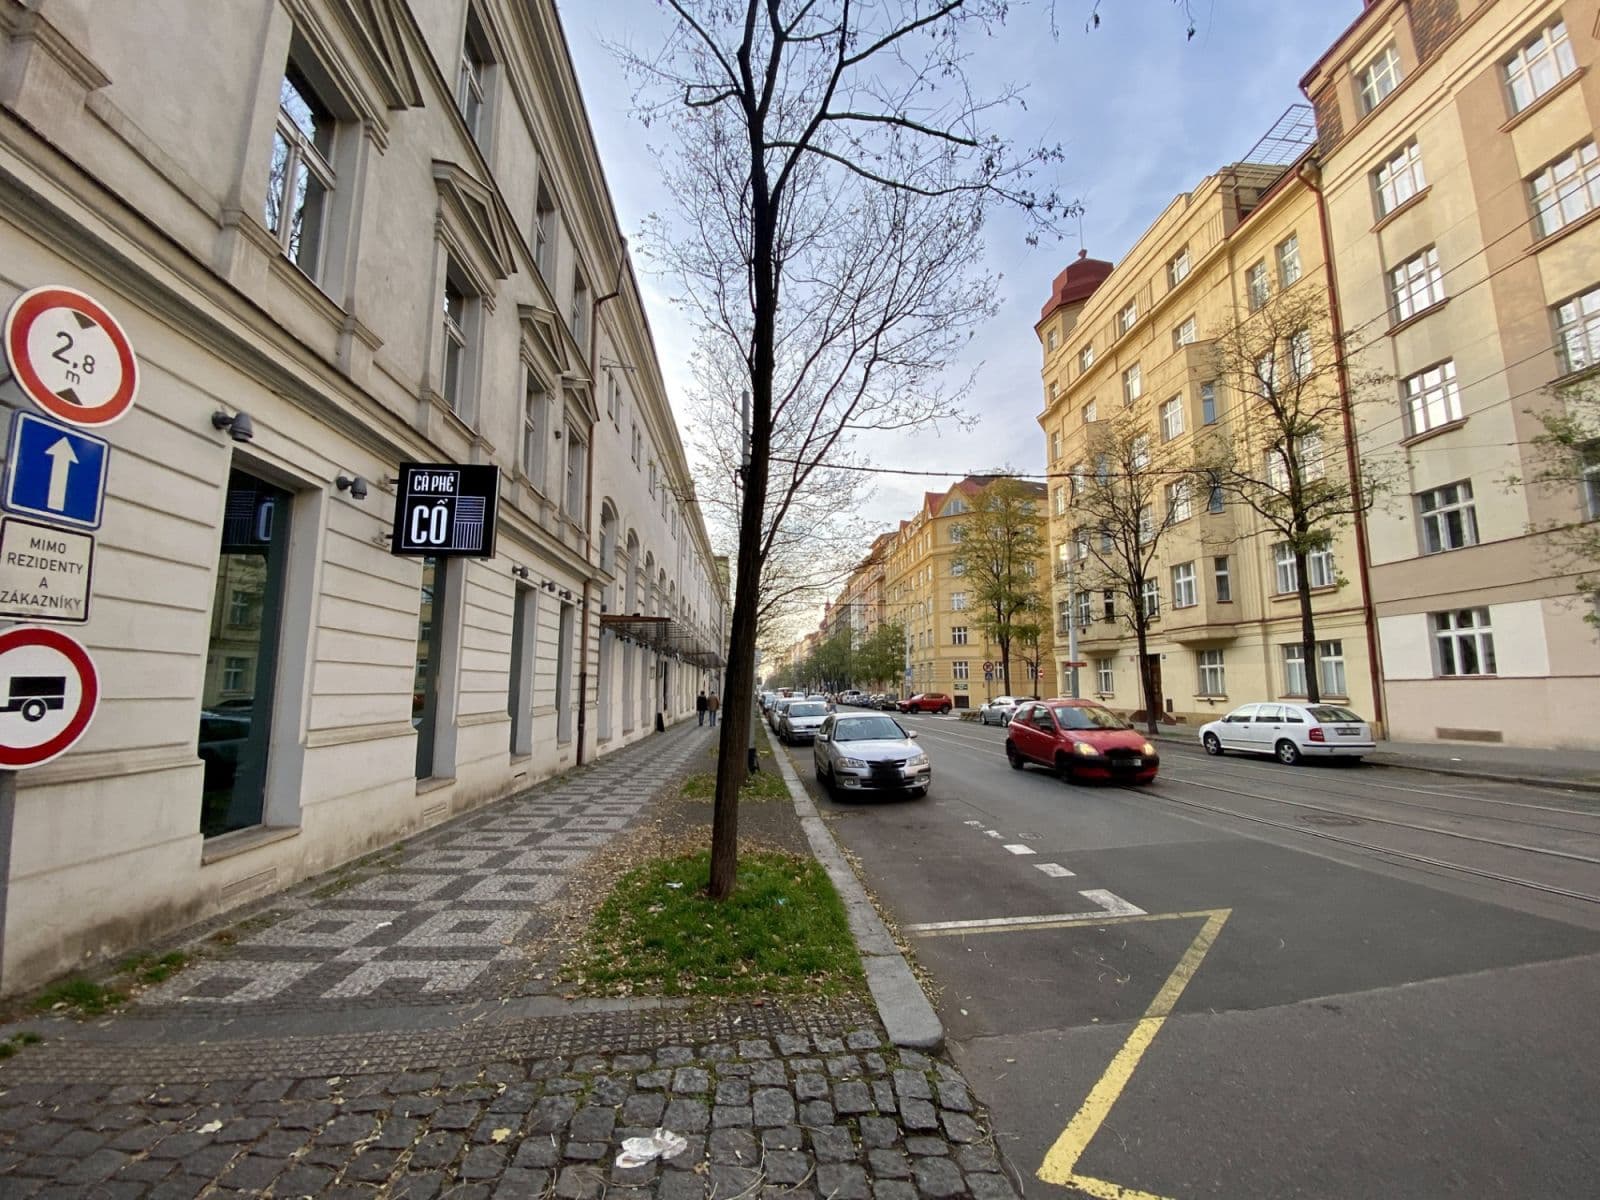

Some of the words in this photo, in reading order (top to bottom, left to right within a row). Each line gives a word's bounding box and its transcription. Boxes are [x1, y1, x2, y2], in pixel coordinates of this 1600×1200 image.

[65, 370, 81, 385] m
[413, 471, 430, 492] CÀ
[430, 472, 454, 493] PHÊ
[30, 537, 66, 555] MIMO
[7, 551, 84, 575] REZIDENTY
[38, 576, 49, 589] A
[0, 590, 82, 610] ZÁKAZNÍKY
